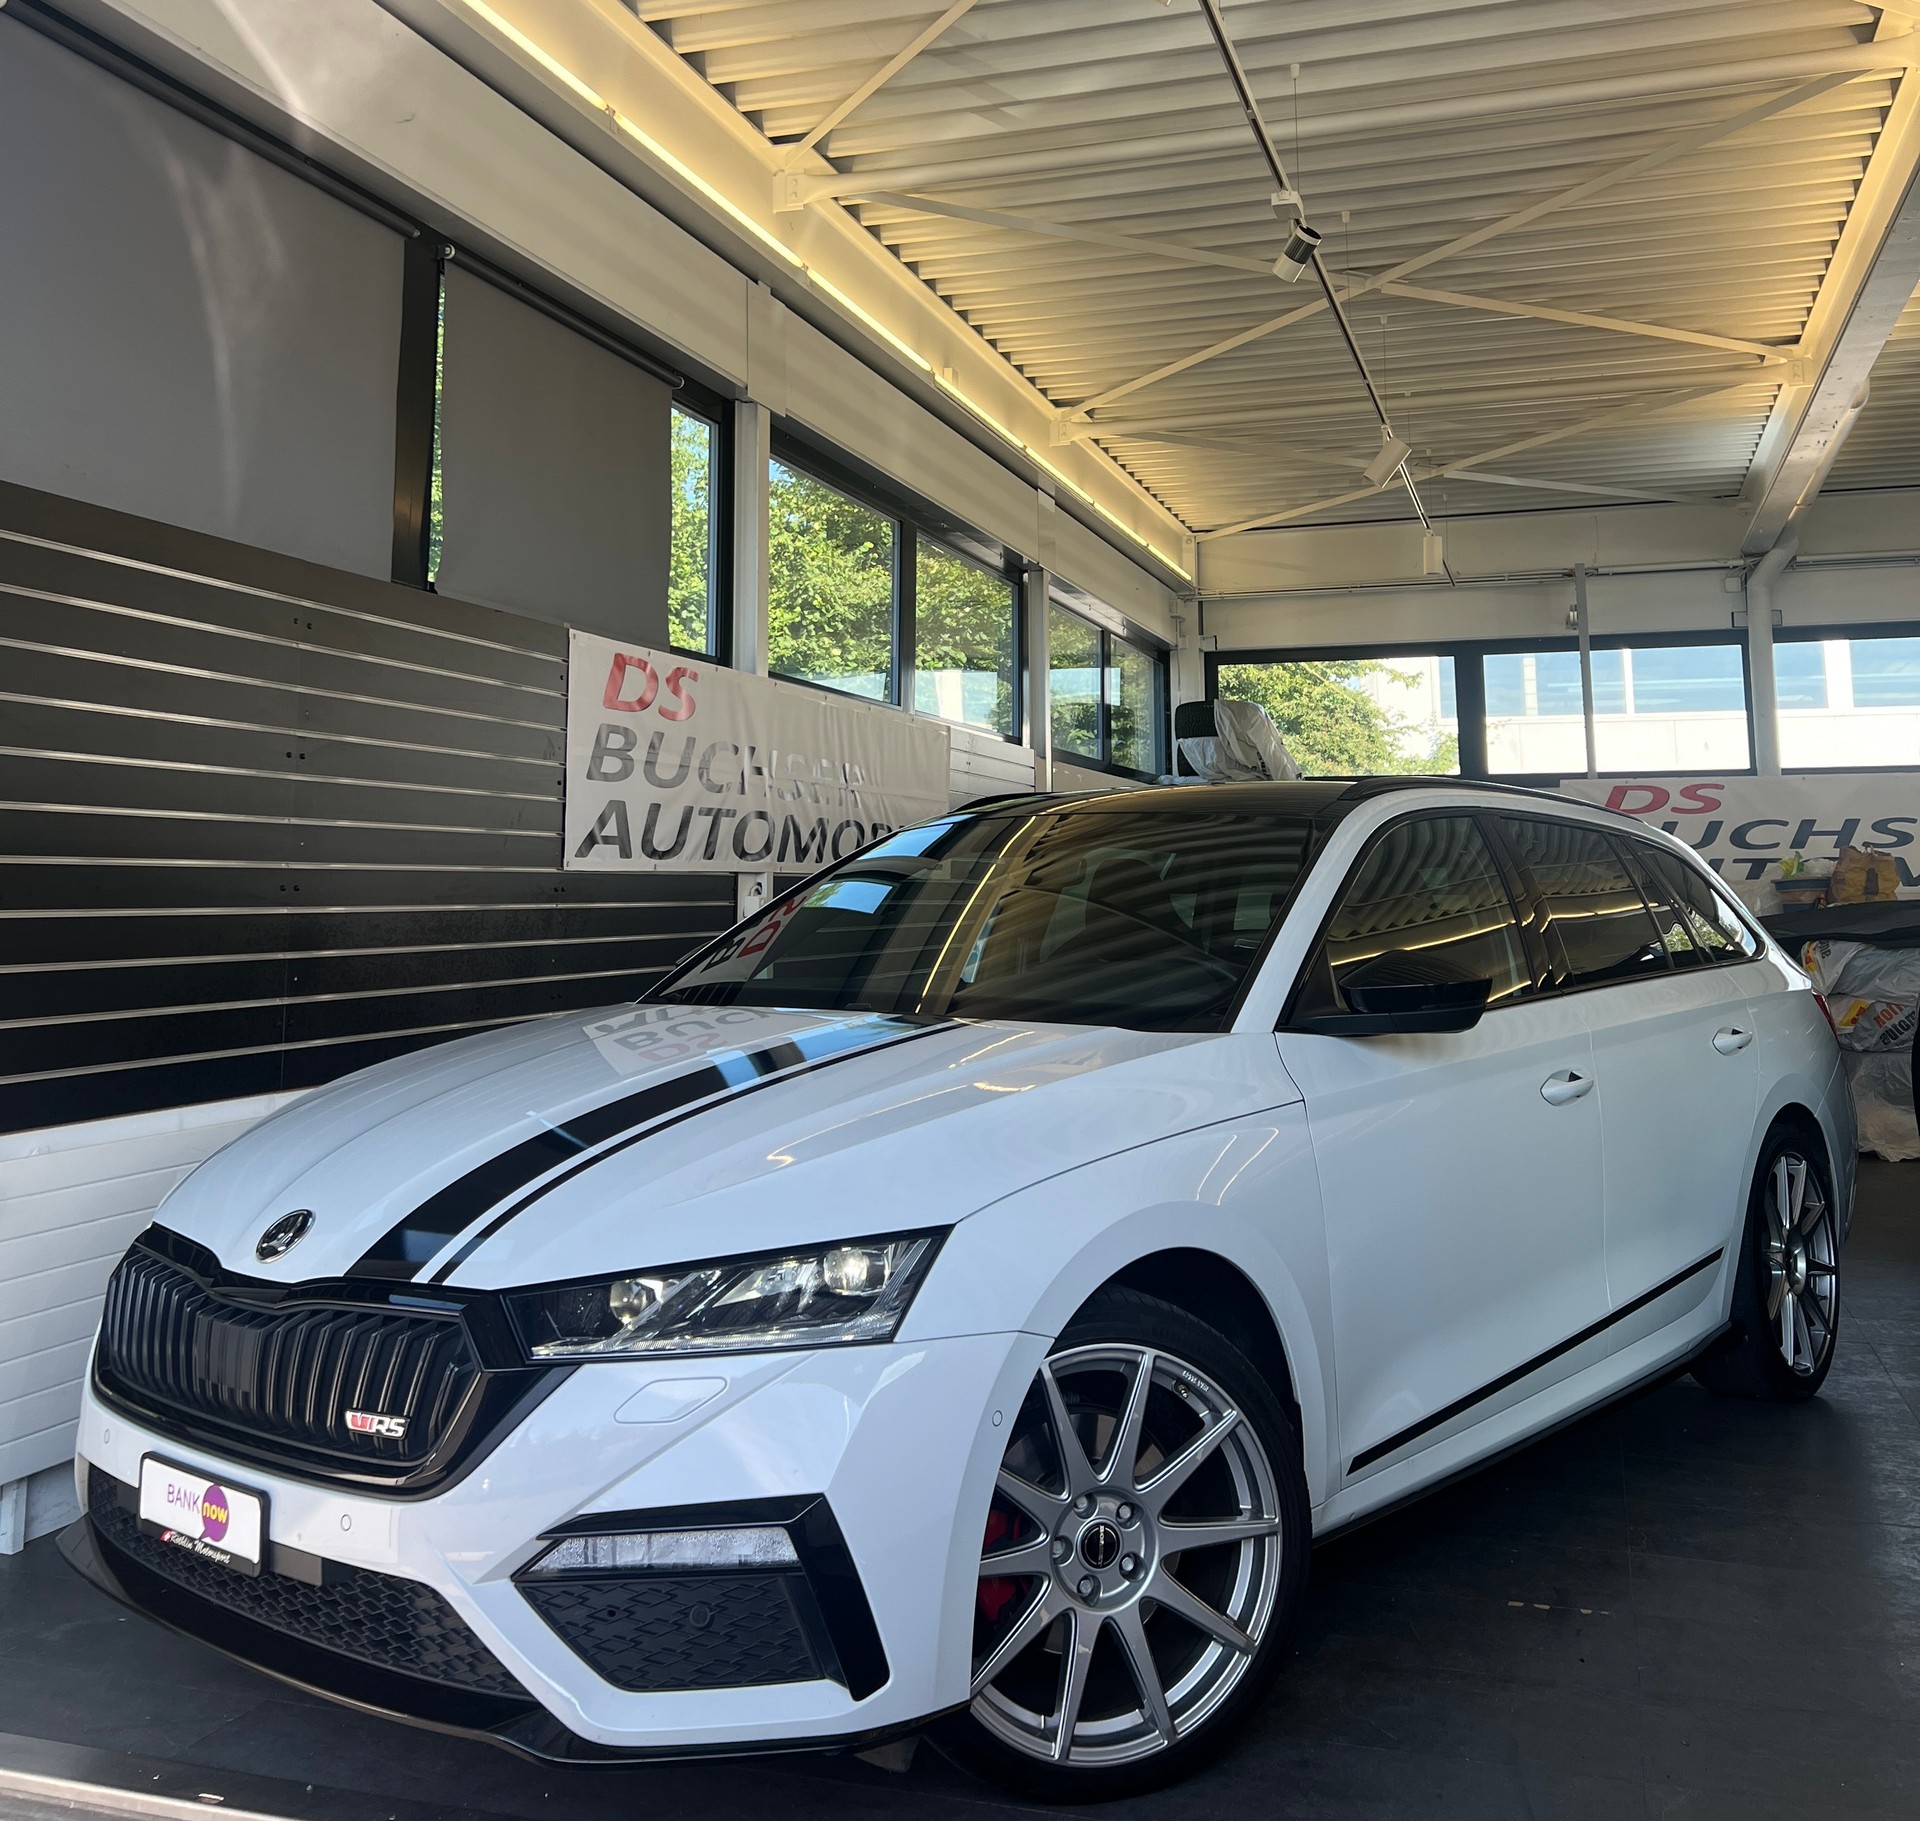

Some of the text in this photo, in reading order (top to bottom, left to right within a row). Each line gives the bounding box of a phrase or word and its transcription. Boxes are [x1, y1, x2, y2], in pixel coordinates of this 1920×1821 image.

[602, 652, 699, 722] DS
[1604, 783, 1726, 815] DS
[1661, 817, 1919, 850] UCHS
[166, 1483, 228, 1524] BANK now
